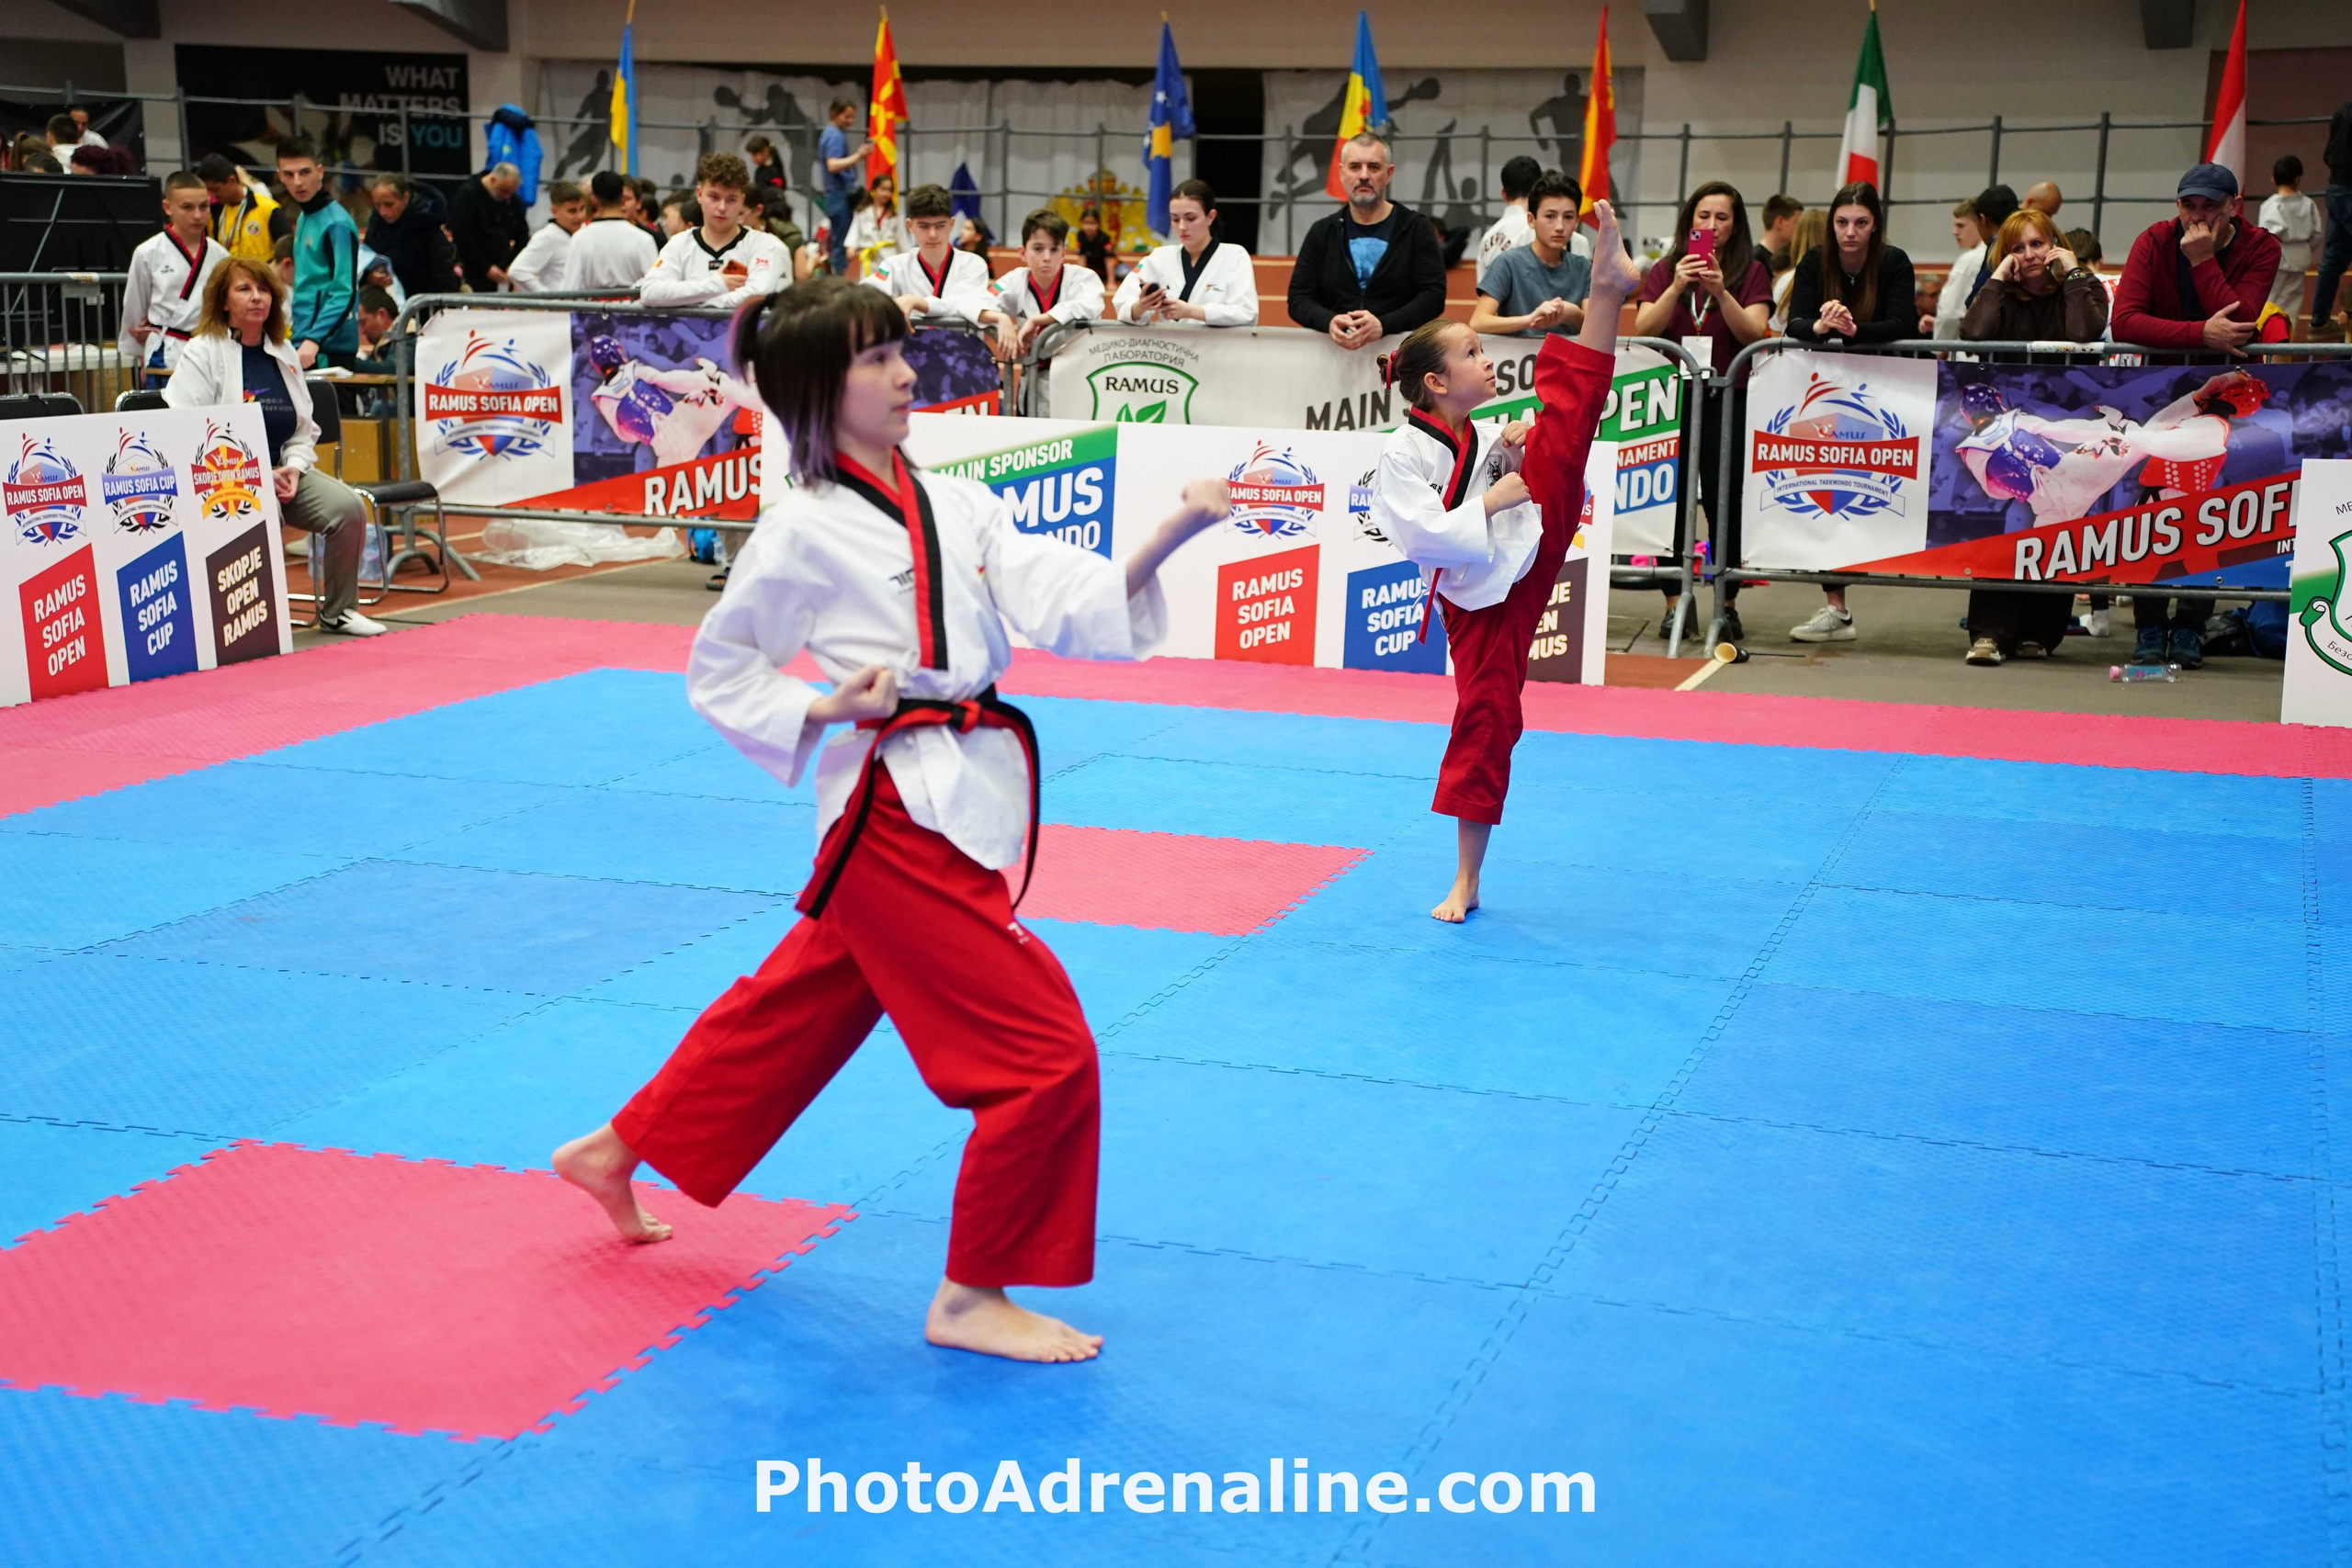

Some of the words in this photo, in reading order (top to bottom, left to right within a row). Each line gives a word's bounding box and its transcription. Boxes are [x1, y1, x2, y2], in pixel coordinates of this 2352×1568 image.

[385, 65, 458, 89] WHAT
[339, 93, 460, 119] MATTERS
[379, 123, 401, 147] IS
[411, 124, 463, 148] YOU
[1089, 338, 1199, 363] МЕДИКО-ДИАГНОСТИЧНА
[1104, 351, 1185, 367] ЛАБОРАТОРИЯ
[1105, 377, 1179, 394] RAMUS
[428, 394, 478, 412] RAMUS
[480, 395, 523, 412] SOFIA
[524, 396, 559, 412] OPEN
[1306, 389, 1391, 431] MAIN
[989, 438, 1073, 478] SPONSOR
[1758, 443, 1815, 462] RAMUS
[1819, 446, 1866, 465] SOFIA
[1871, 447, 1914, 467] OPEN
[104, 480, 133, 496] RAMUS
[134, 477, 159, 493] SOFIA
[159, 475, 175, 491] CUP
[193, 471, 219, 485] SKOPJE
[219, 469, 235, 483] OPEN
[236, 467, 259, 481] RAMUS
[644, 452, 761, 515] RAMUS
[1776, 479, 1817, 492] INTERNATIONAL
[1819, 479, 1852, 488] TAEKWONDO
[1853, 480, 1889, 497] TOURNAMENT
[6, 489, 38, 506] RAMUS
[38, 486, 62, 502] SOFIA
[62, 484, 84, 501] OPEN
[1261, 489, 1293, 502] SOFIA
[1294, 490, 1322, 503] OPEN
[2014, 506, 2182, 581] RAMUS
[130, 559, 178, 608] RAMUS
[218, 547, 263, 593] SKOPJE
[1232, 568, 1304, 601] RAMUS
[34, 573, 86, 623] RAMUS
[226, 577, 260, 615] OPEN
[1238, 595, 1295, 625] SOFIA
[138, 591, 177, 632] SOFIA
[223, 600, 267, 647] RAMUS
[1367, 602, 1425, 633] SOFIA
[41, 606, 85, 649] SOFIA
[147, 621, 174, 656] CUP
[1239, 620, 1291, 649] OPEN
[47, 635, 86, 677] OPEN
[1374, 630, 1416, 656] CUP
